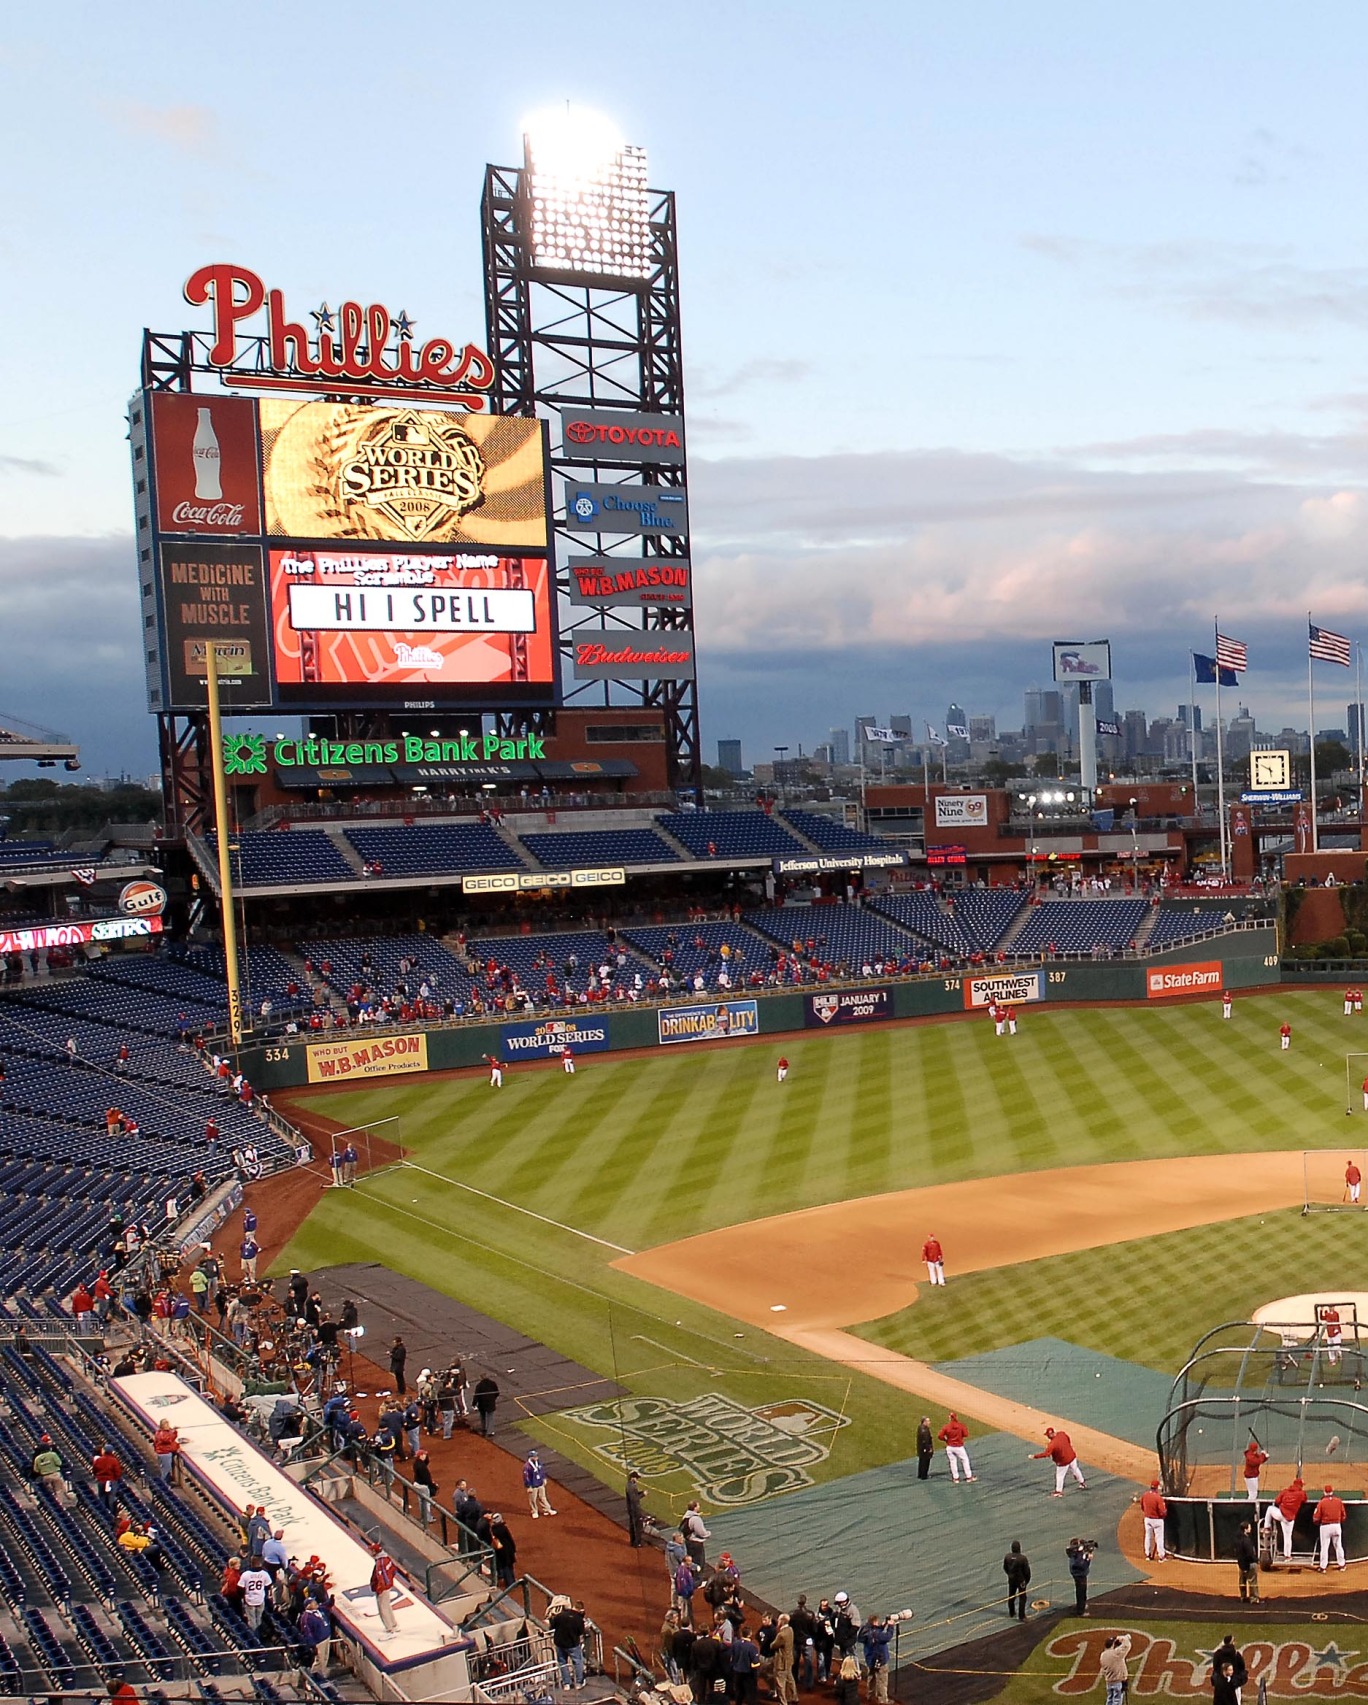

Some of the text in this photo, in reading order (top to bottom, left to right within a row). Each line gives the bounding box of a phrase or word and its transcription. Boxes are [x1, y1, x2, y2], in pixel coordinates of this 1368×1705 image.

[185, 263, 495, 390] Phillies
[595, 424, 681, 448] TOYOTA
[362, 444, 458, 471] WORLD
[342, 461, 476, 498] SERIES
[399, 501, 431, 512] 2008
[603, 495, 657, 512] Choose
[281, 552, 500, 574] The Phillies Player Name
[353, 570, 437, 586] Scramble
[181, 603, 251, 625] MUSCLE
[335, 593, 495, 623] HI I SPELL
[576, 644, 691, 667] Budweiser
[404, 700, 435, 709] PHILIPS
[274, 732, 546, 766] Citizens Bank Park
[418, 768, 467, 776] HARRY
[937, 799, 964, 808] Ninety
[938, 807, 964, 817] Nine
[779, 854, 903, 872] Jefferson University Hospitals
[465, 871, 623, 890] GEICO GEICO GEICO
[124, 890, 163, 911] Gulf
[1264, 956, 1278, 967] 409
[944, 979, 960, 991] 374
[973, 976, 1036, 993] SOUTHWEST
[1049, 972, 1066, 983] 387
[840, 992, 887, 1007] JANUARY 1
[983, 988, 1028, 1002] AIRLINES
[852, 1004, 875, 1016] 2009
[507, 1028, 605, 1050] WORLD SERIES
[265, 1048, 290, 1062] 334
[312, 1046, 348, 1057] WHO BUT
[364, 1061, 421, 1074] Office Products
[674, 1397, 821, 1467] WORLD
[585, 1398, 809, 1505] SERIES
[219, 1458, 306, 1527] Citizens Bank Park
[248, 1580, 263, 1591] 26
